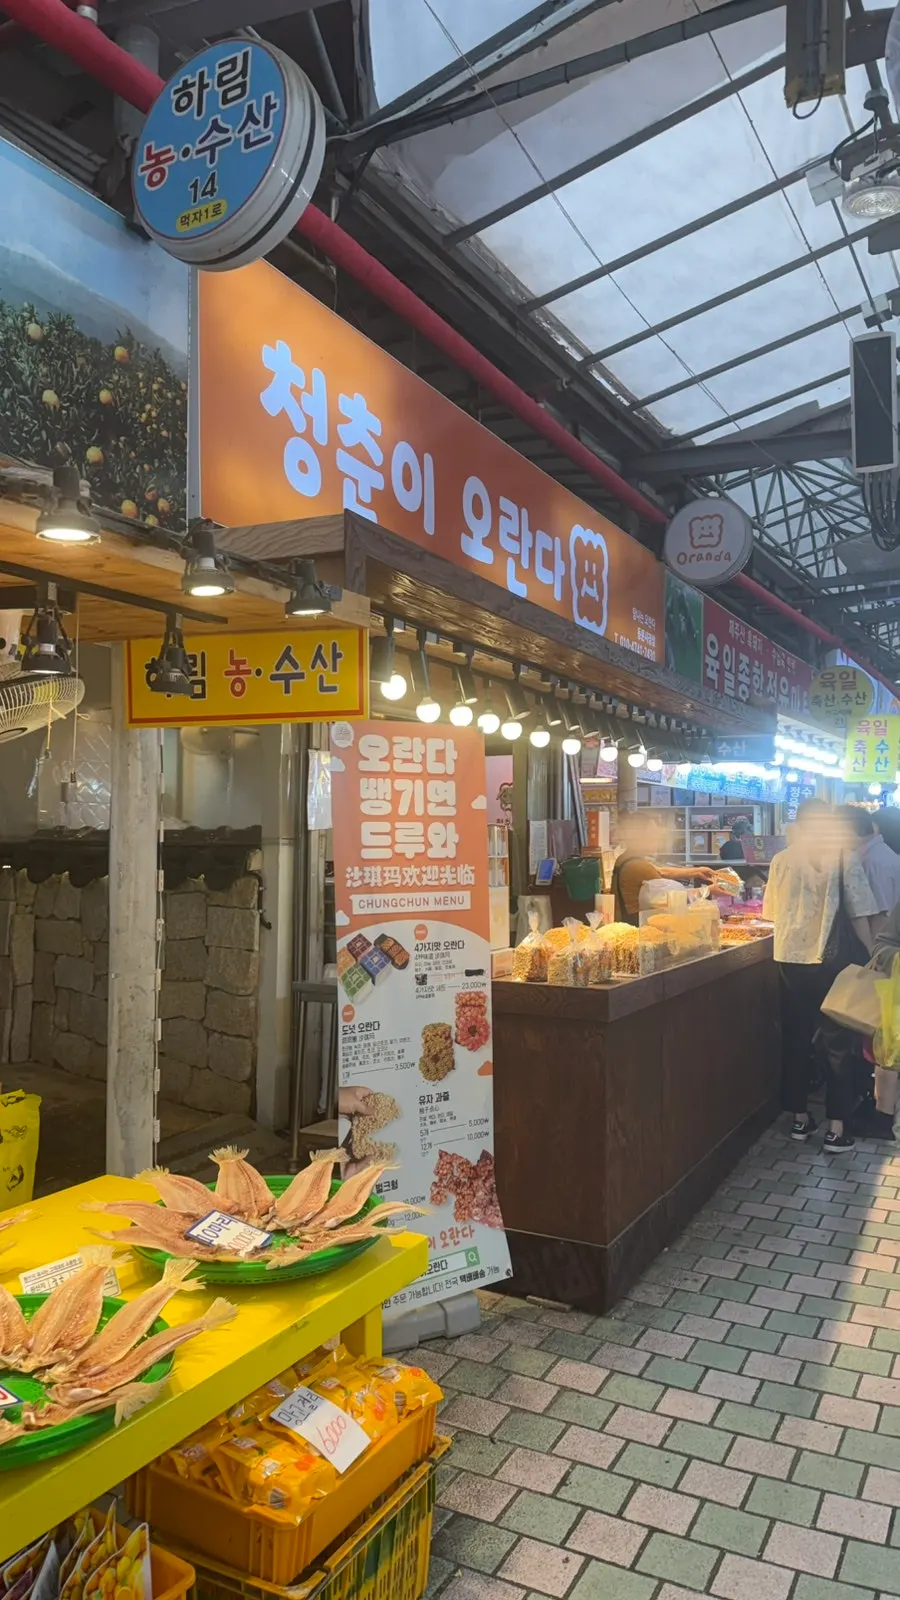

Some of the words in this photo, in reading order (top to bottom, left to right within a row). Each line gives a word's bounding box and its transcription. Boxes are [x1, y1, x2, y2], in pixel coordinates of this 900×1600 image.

[174, 50, 250, 117] 하림
[189, 172, 217, 203] 14
[180, 202, 223, 227] 먹자1로
[260, 340, 434, 536] 청춘이
[461, 476, 565, 601] 오란다
[677, 551, 731, 566] Oranda
[820, 670, 857, 691] 육일
[857, 719, 888, 737] 육일
[358, 734, 458, 775] 오란다
[361, 821, 459, 860] 드루와
[359, 896, 430, 910] CHUNGCHUN
[434, 896, 465, 907] MENU
[414, 941, 441, 953] 4가지맛
[443, 939, 465, 951] 오란다
[342, 1024, 356, 1036] 도넛
[357, 1020, 381, 1034] 오란다
[439, 1225, 476, 1249] 오란다
[393, 1293, 407, 1307] 주문
[315, 1415, 347, 1455] 6000
